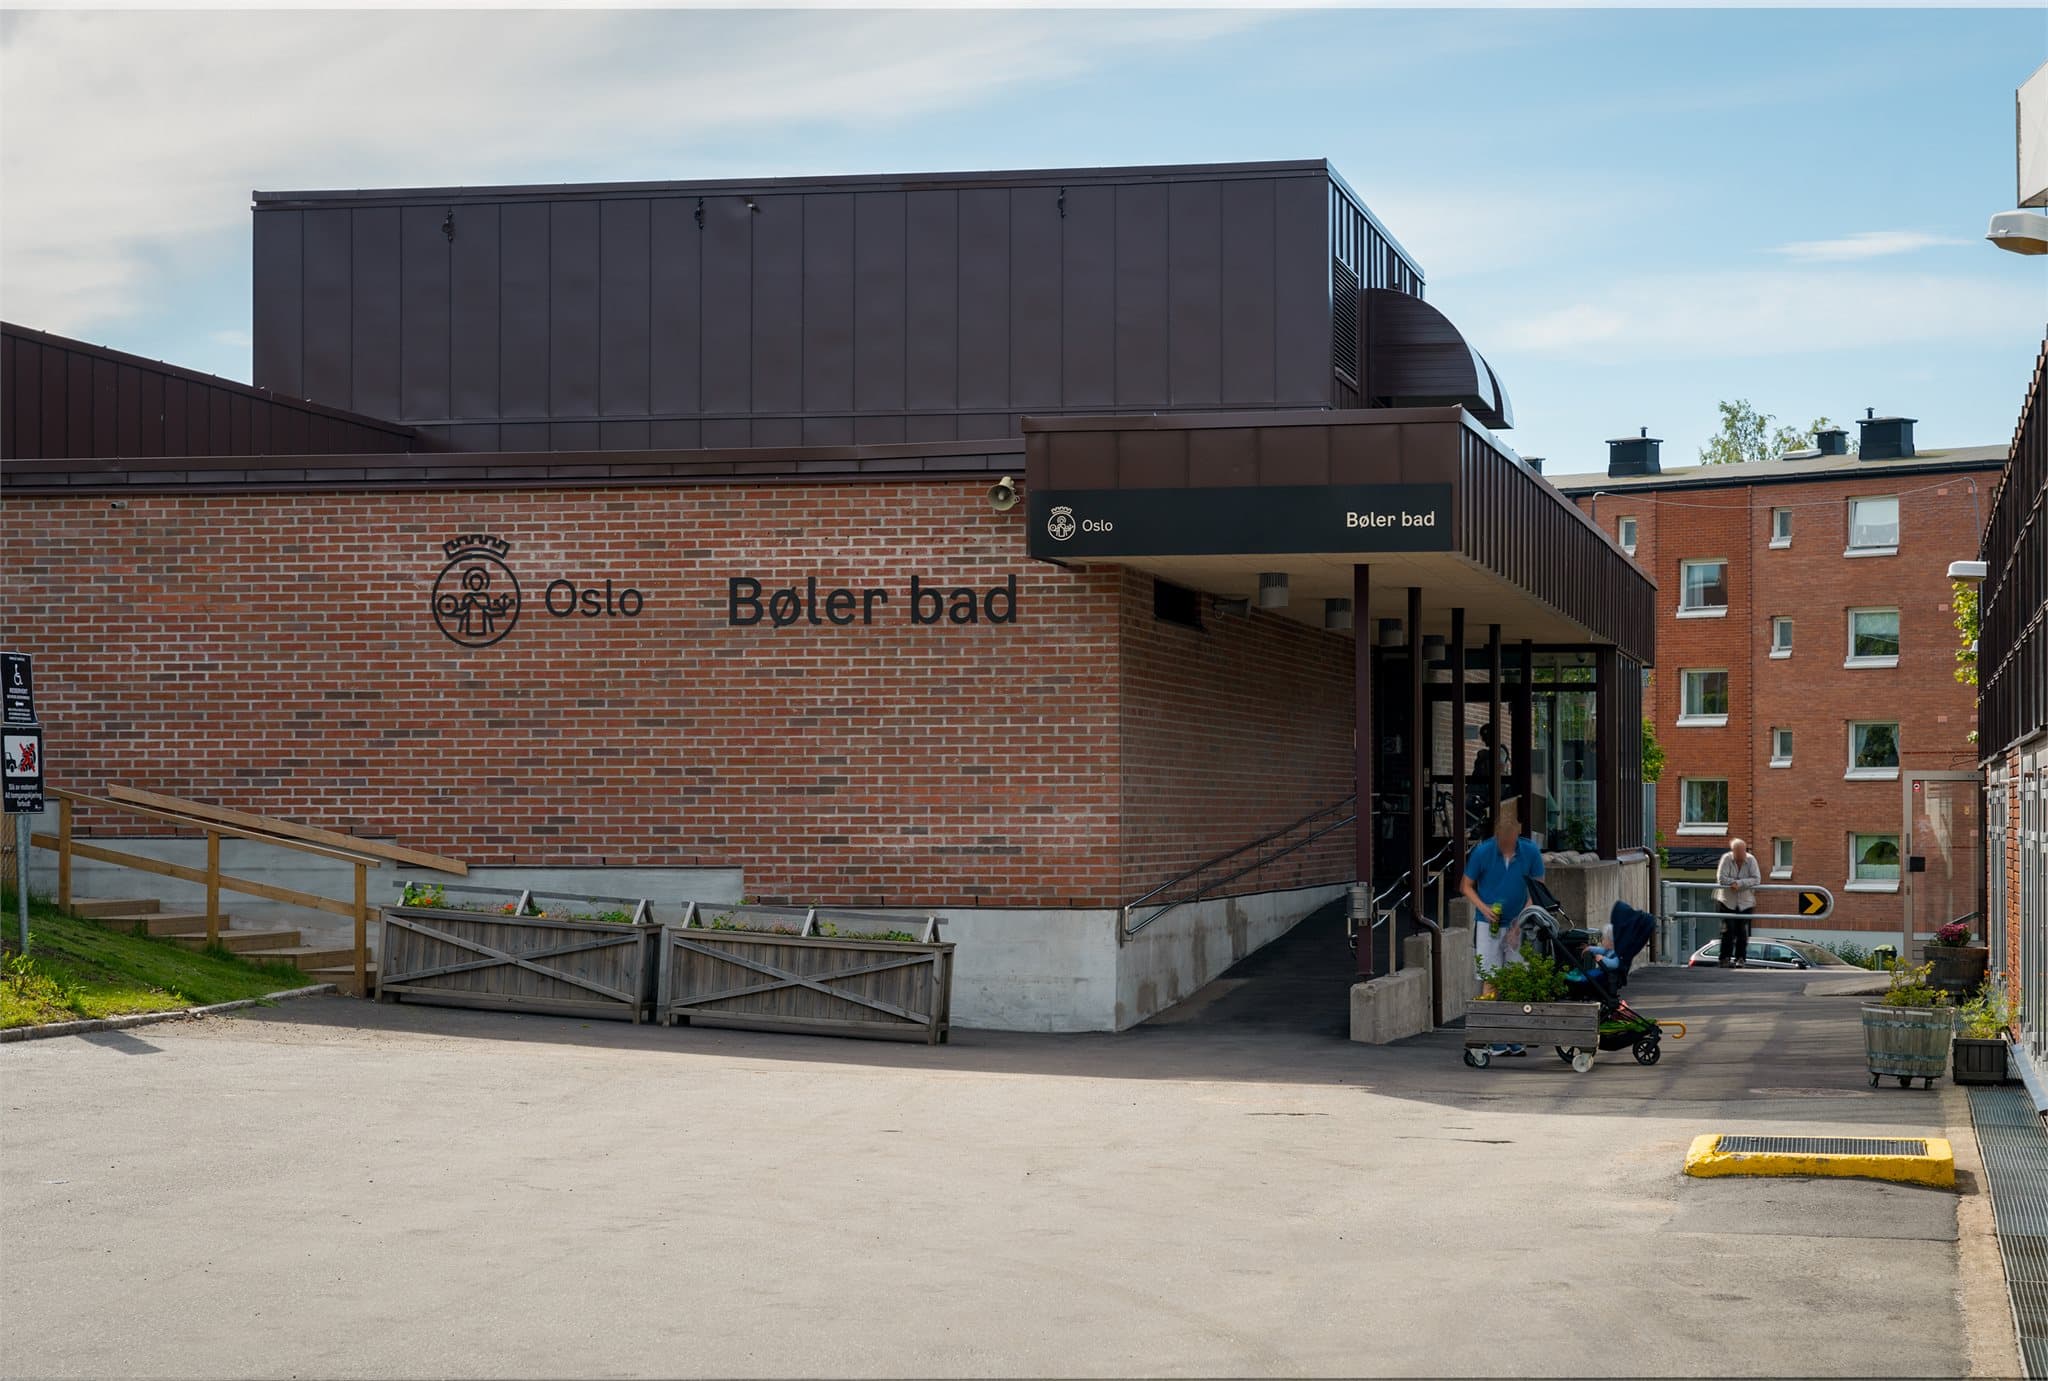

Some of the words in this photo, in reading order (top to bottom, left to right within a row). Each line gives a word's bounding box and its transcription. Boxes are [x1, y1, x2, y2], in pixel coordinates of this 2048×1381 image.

[1082, 519, 1114, 532] Oslo
[1346, 511, 1396, 529] Bøler
[1401, 510, 1435, 527] bad
[544, 579, 644, 618] Oslo
[728, 576, 889, 629] Bøler
[910, 573, 1018, 625] bad
